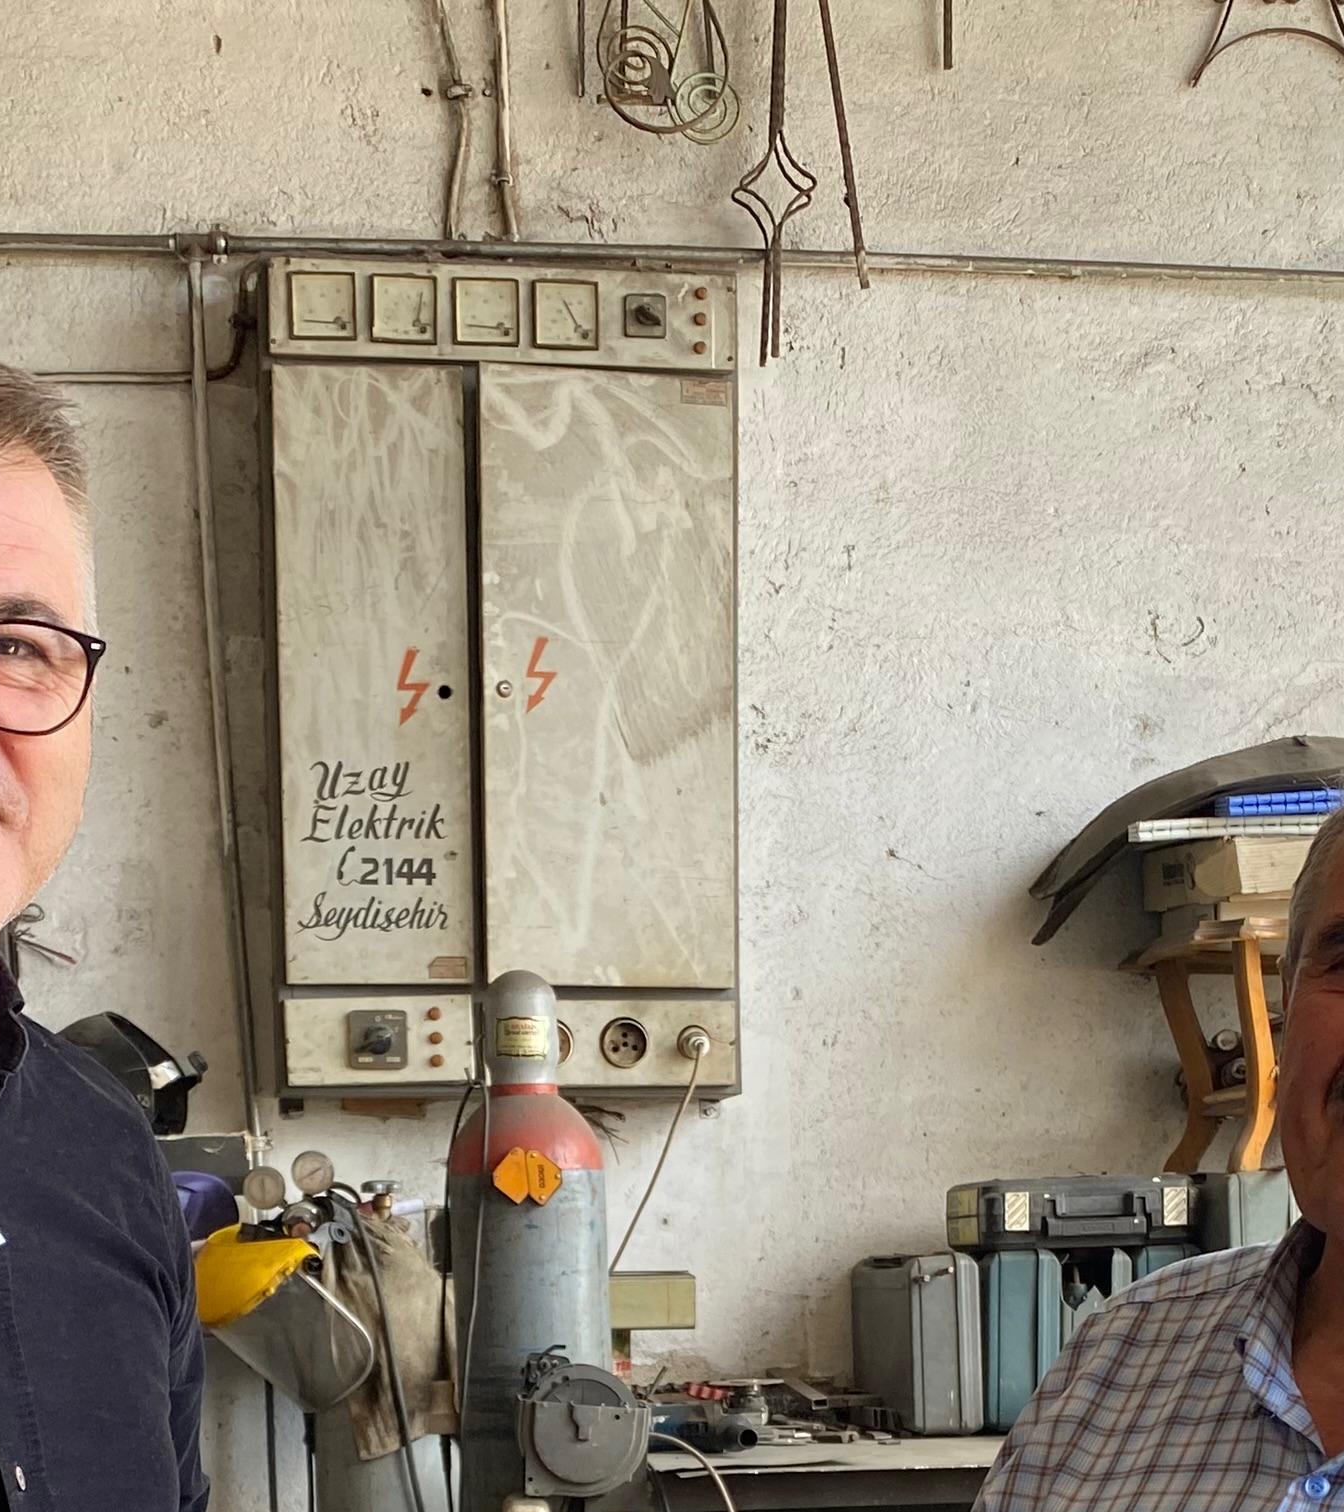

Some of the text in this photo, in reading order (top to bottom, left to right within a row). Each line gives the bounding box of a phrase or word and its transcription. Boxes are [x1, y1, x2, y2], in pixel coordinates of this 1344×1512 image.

[310, 761, 413, 802] Uzay
[300, 803, 448, 842] Elektrik
[360, 858, 436, 886] 2144
